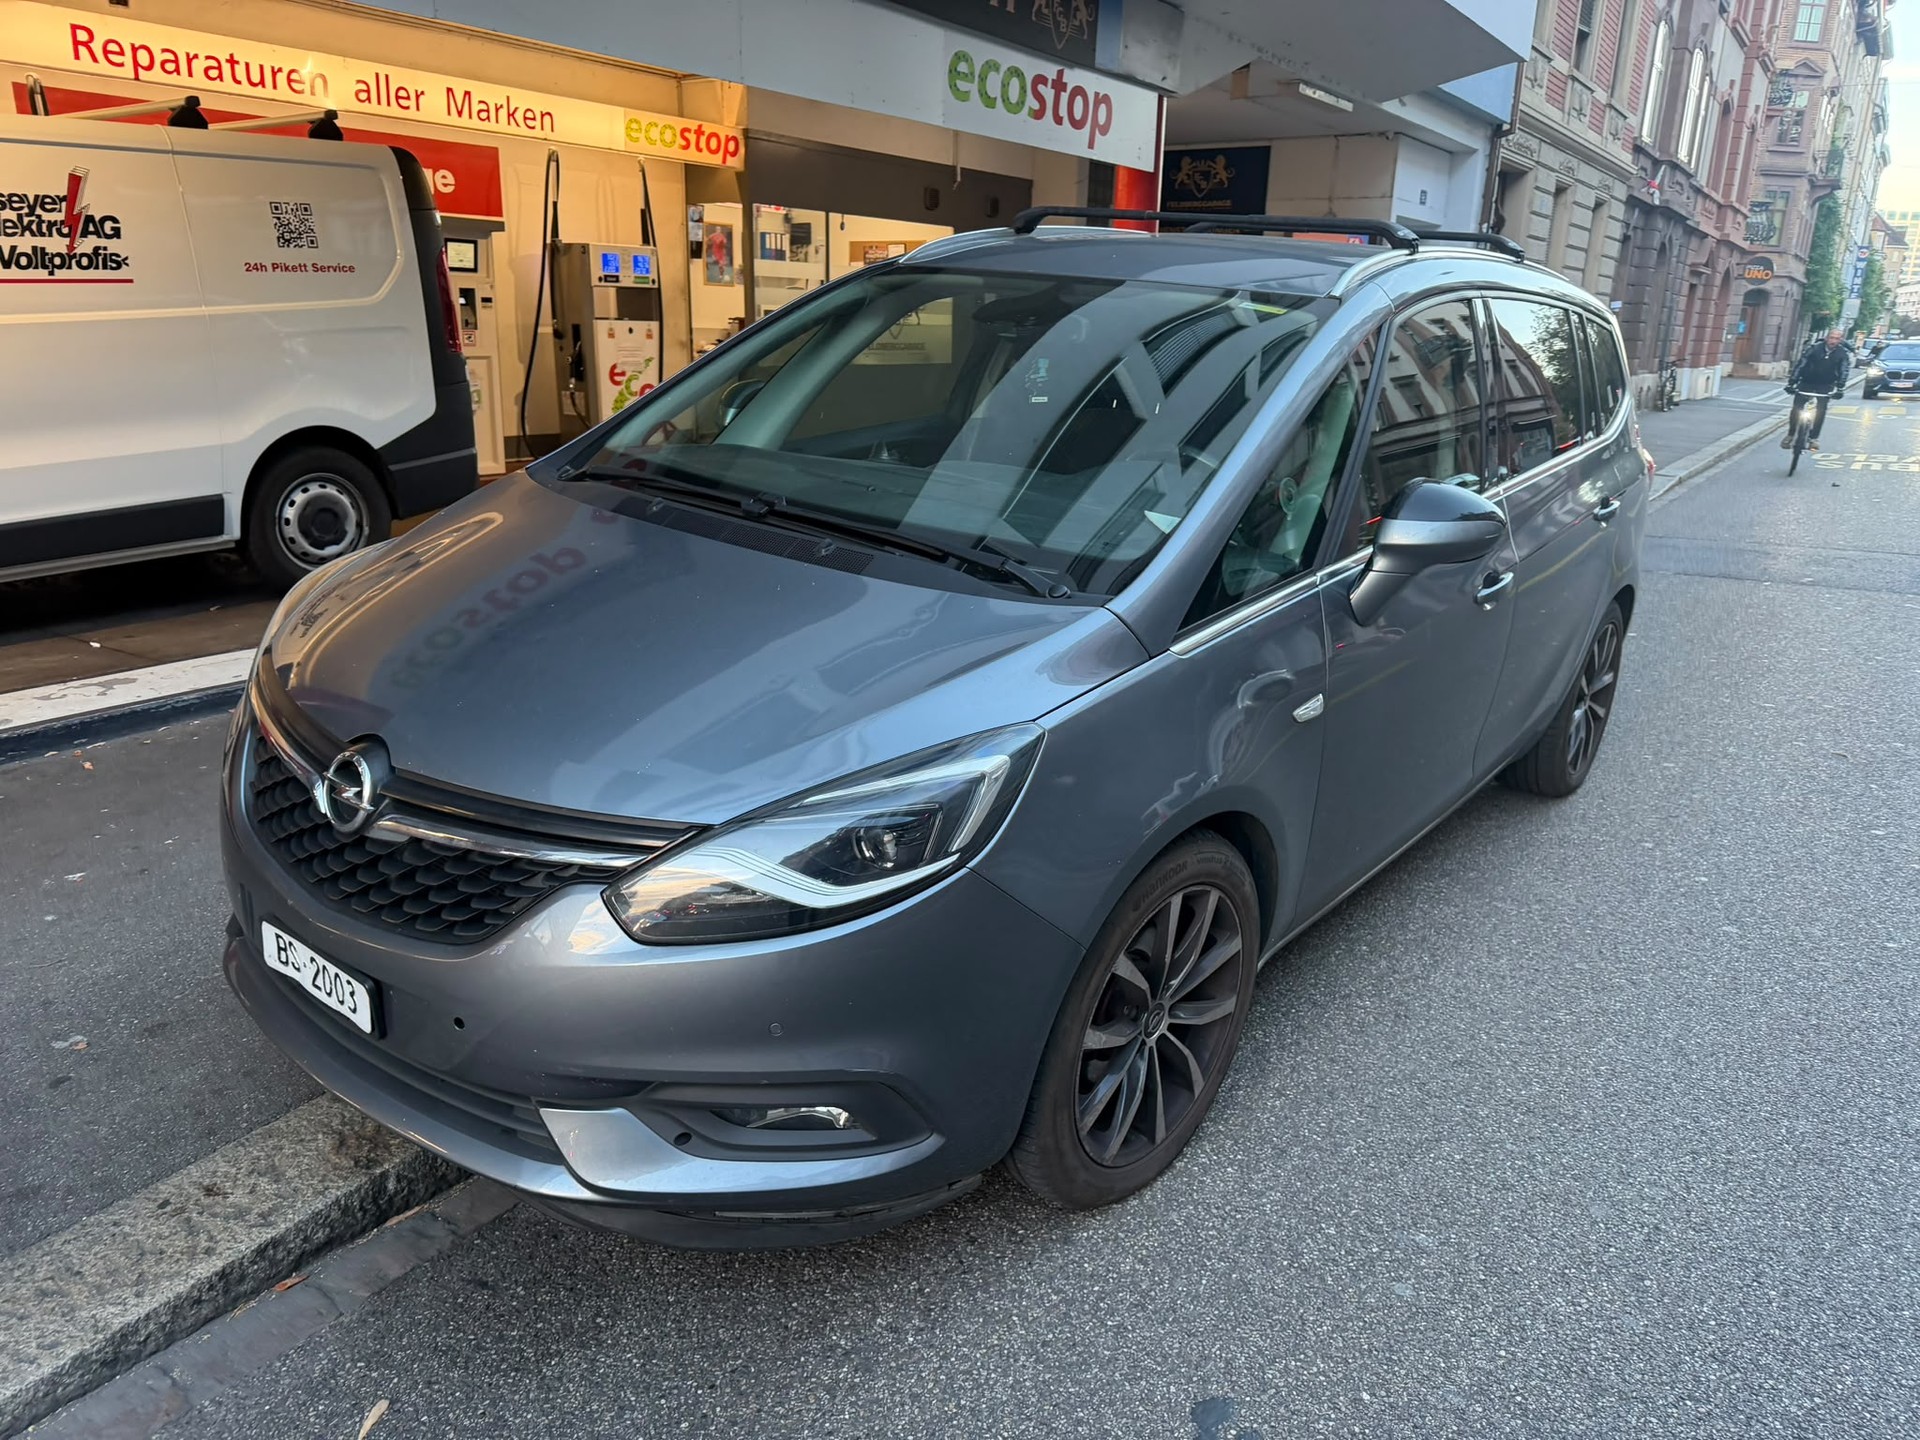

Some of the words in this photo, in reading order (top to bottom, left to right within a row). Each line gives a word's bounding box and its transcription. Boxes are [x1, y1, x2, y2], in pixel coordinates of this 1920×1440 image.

[69, 23, 330, 98] Reparaturen
[354, 72, 425, 112] aller
[445, 87, 555, 133] Marken
[947, 49, 1113, 150] ecostop
[625, 116, 740, 164] ecostop
[0, 213, 73, 238] ektro
[79, 214, 122, 239] AG
[244, 262, 268, 273] 24h
[271, 262, 309, 273] Pikett
[312, 262, 356, 273] Service
[1743, 269, 1773, 280] UNO
